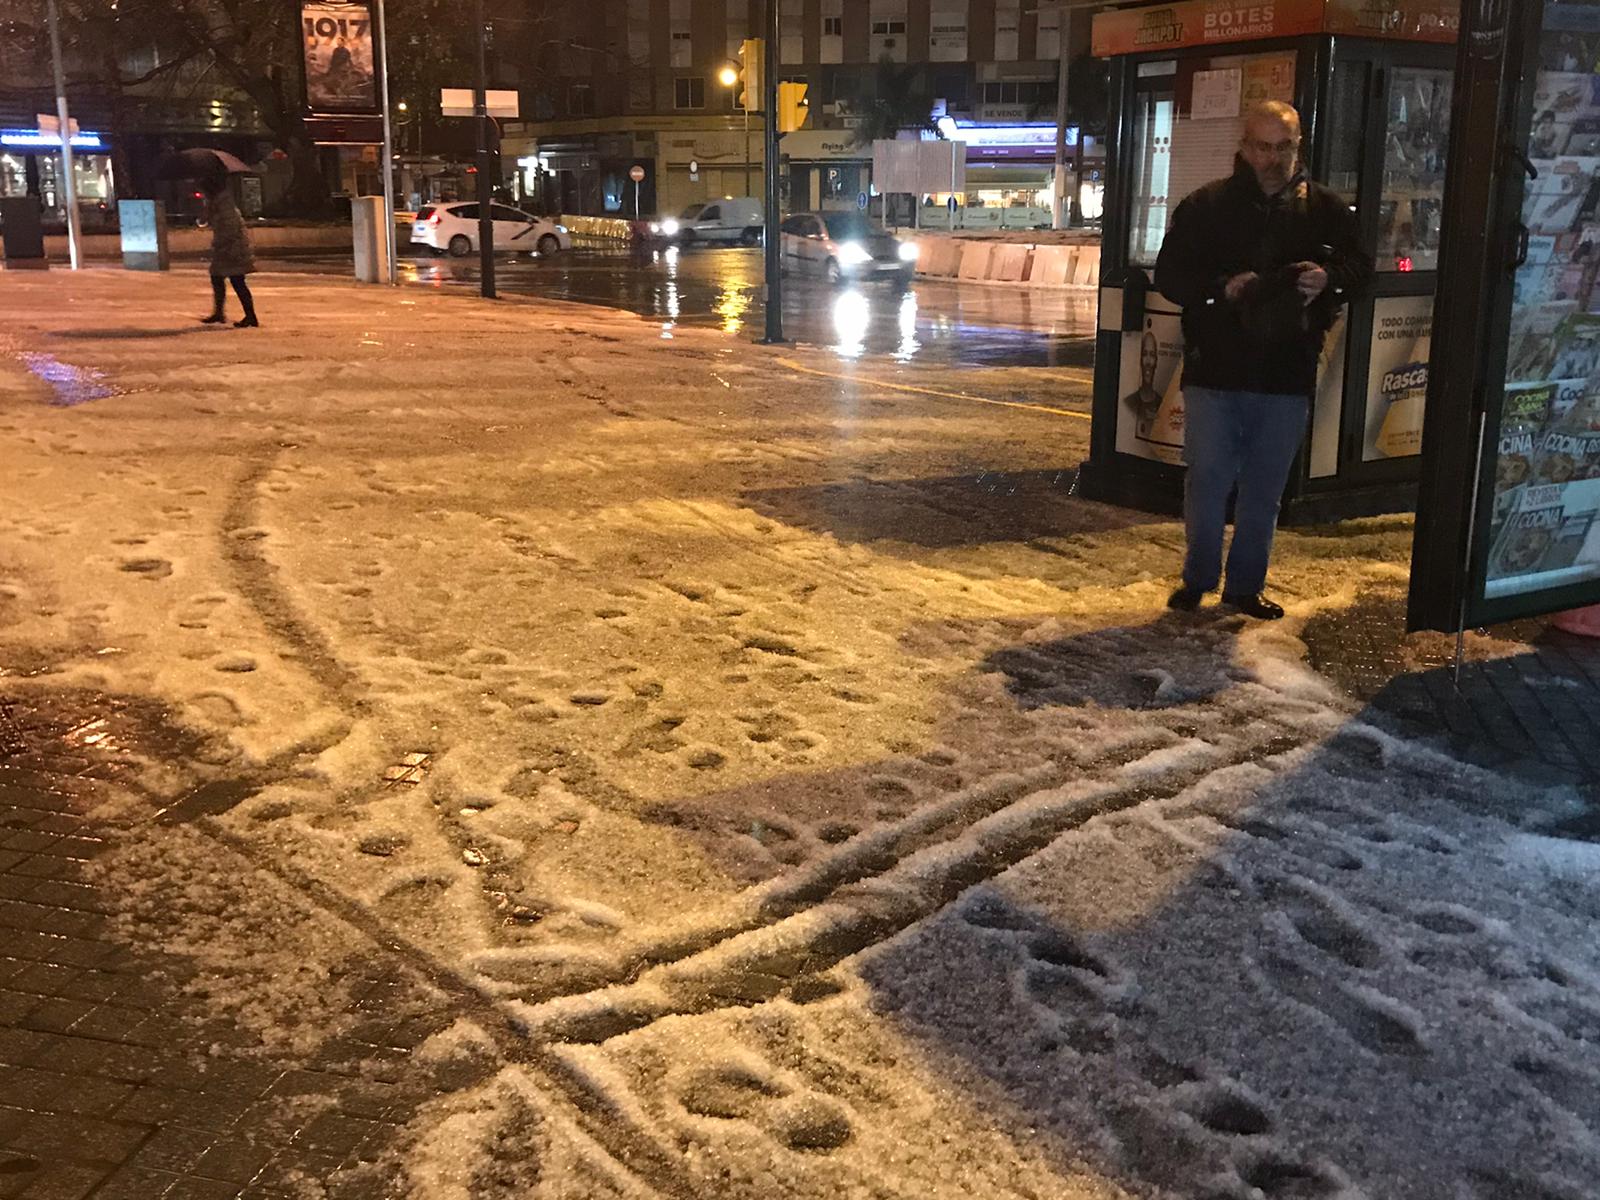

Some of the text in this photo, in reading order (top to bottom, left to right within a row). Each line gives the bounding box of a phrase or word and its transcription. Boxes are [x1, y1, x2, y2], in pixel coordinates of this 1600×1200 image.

[1204, 6, 1274, 28] BOTES
[304, 17, 368, 46] 1917
[1135, 23, 1184, 45] JACKPOT
[1204, 24, 1274, 40] MILLONARIOS
[984, 109, 1023, 117] SE VENDE
[821, 142, 844, 153] flying
[829, 169, 838, 180] P
[1381, 316, 1403, 327] TODO
[1377, 330, 1395, 341] CON
[1498, 433, 1533, 455] CINA
[1518, 508, 1563, 529] COCINA
